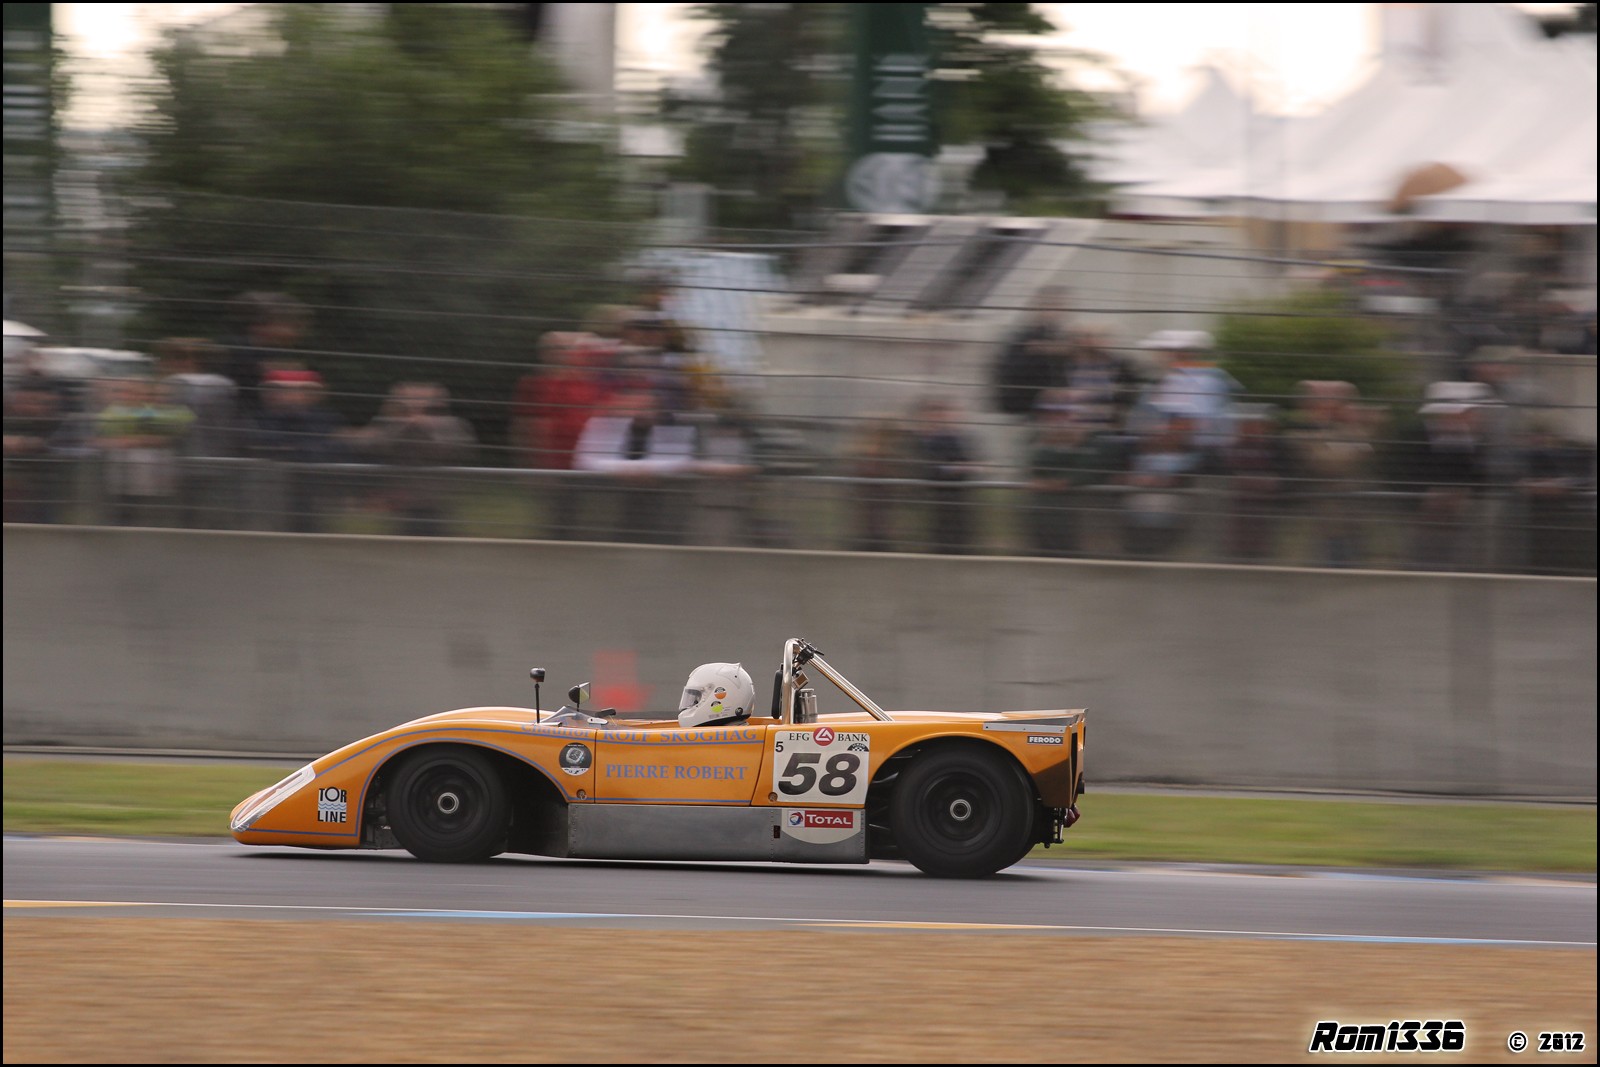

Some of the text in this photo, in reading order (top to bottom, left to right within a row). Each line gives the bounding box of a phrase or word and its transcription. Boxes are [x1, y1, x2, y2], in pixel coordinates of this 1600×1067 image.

[789, 732, 868, 742] EFG BANK
[775, 741, 784, 753] 5
[606, 764, 748, 780] PIERRE ROBERT
[778, 752, 861, 796] 58
[318, 786, 347, 802] TOR
[317, 810, 347, 823] LINE
